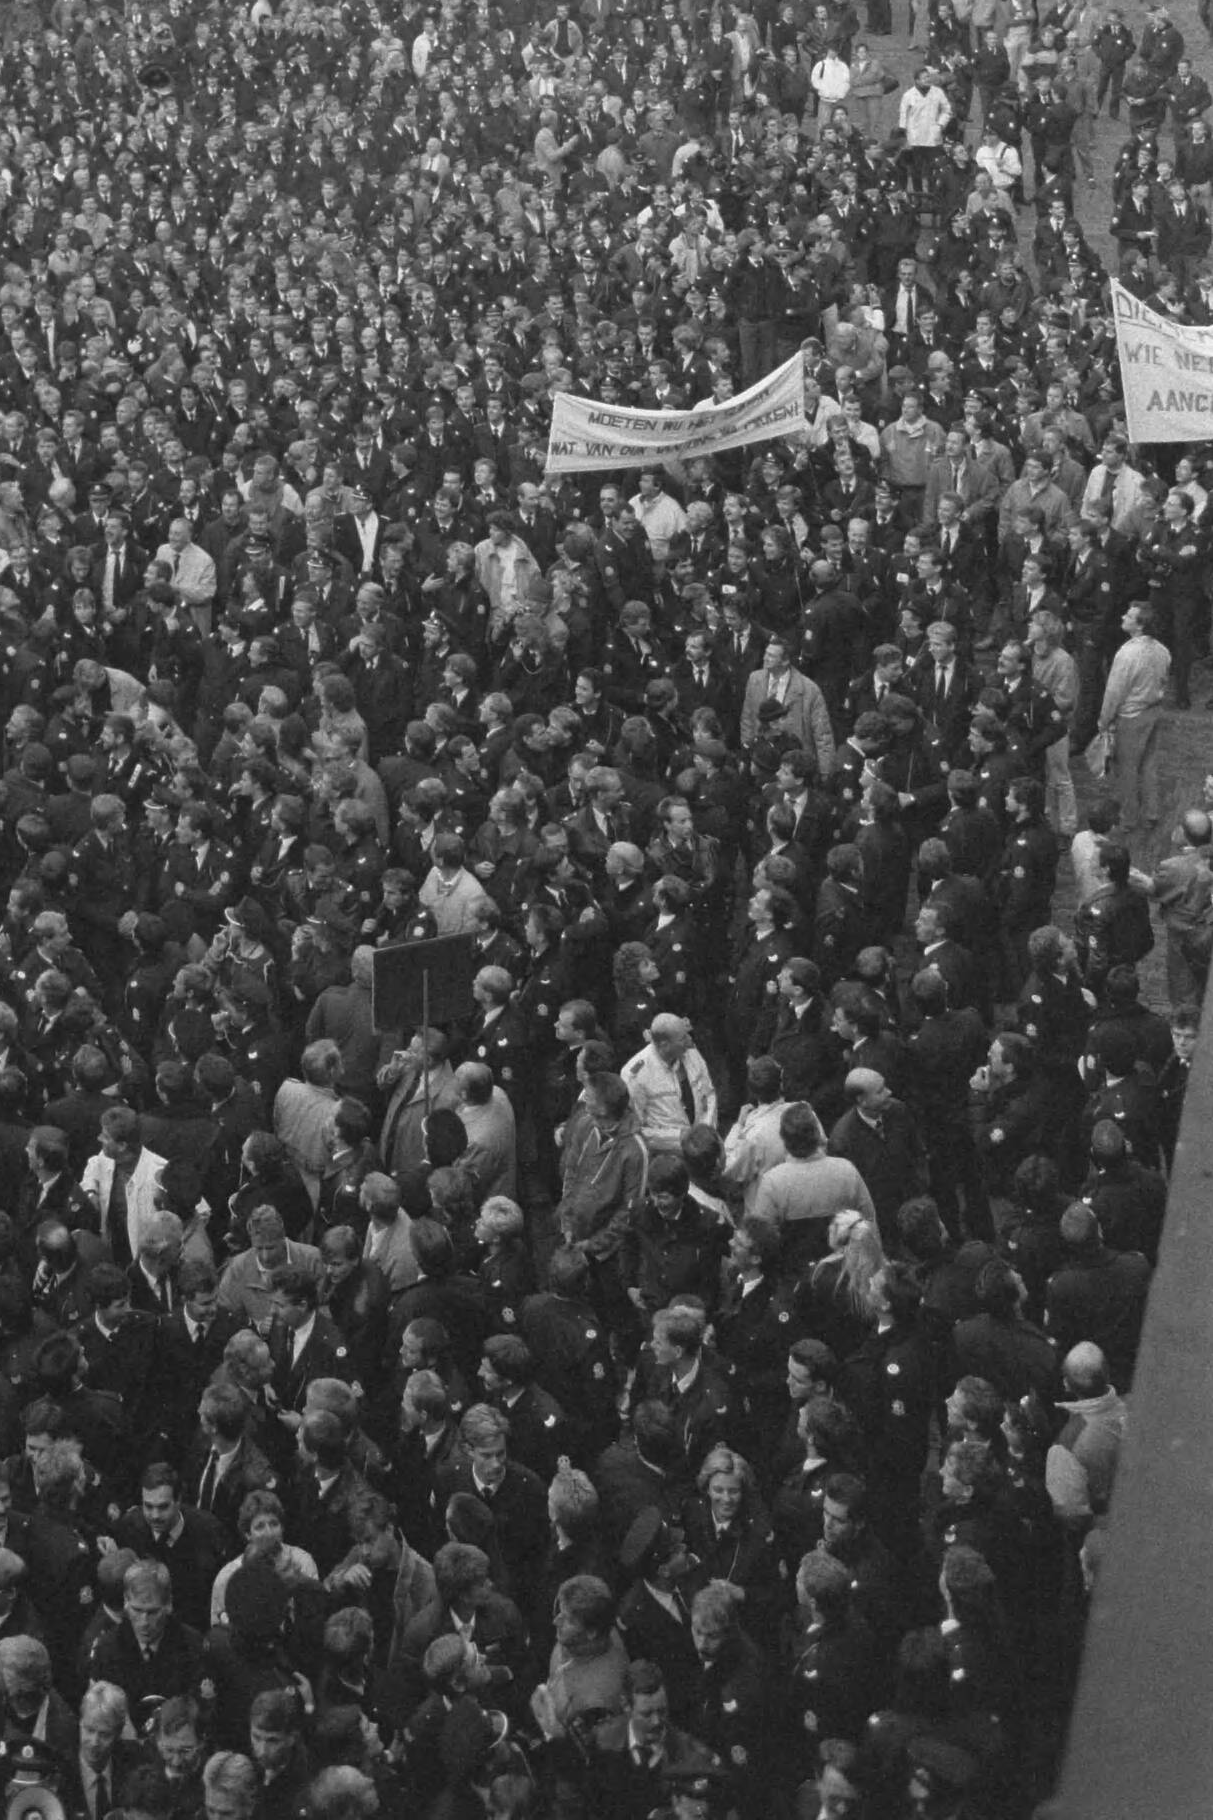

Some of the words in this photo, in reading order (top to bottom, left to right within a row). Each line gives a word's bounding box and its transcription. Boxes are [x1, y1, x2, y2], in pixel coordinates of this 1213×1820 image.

[1124, 341, 1164, 367] WIE
[587, 411, 658, 431] MOETEN
[551, 441, 577, 456] WAT
[585, 441, 616, 457] VAN
